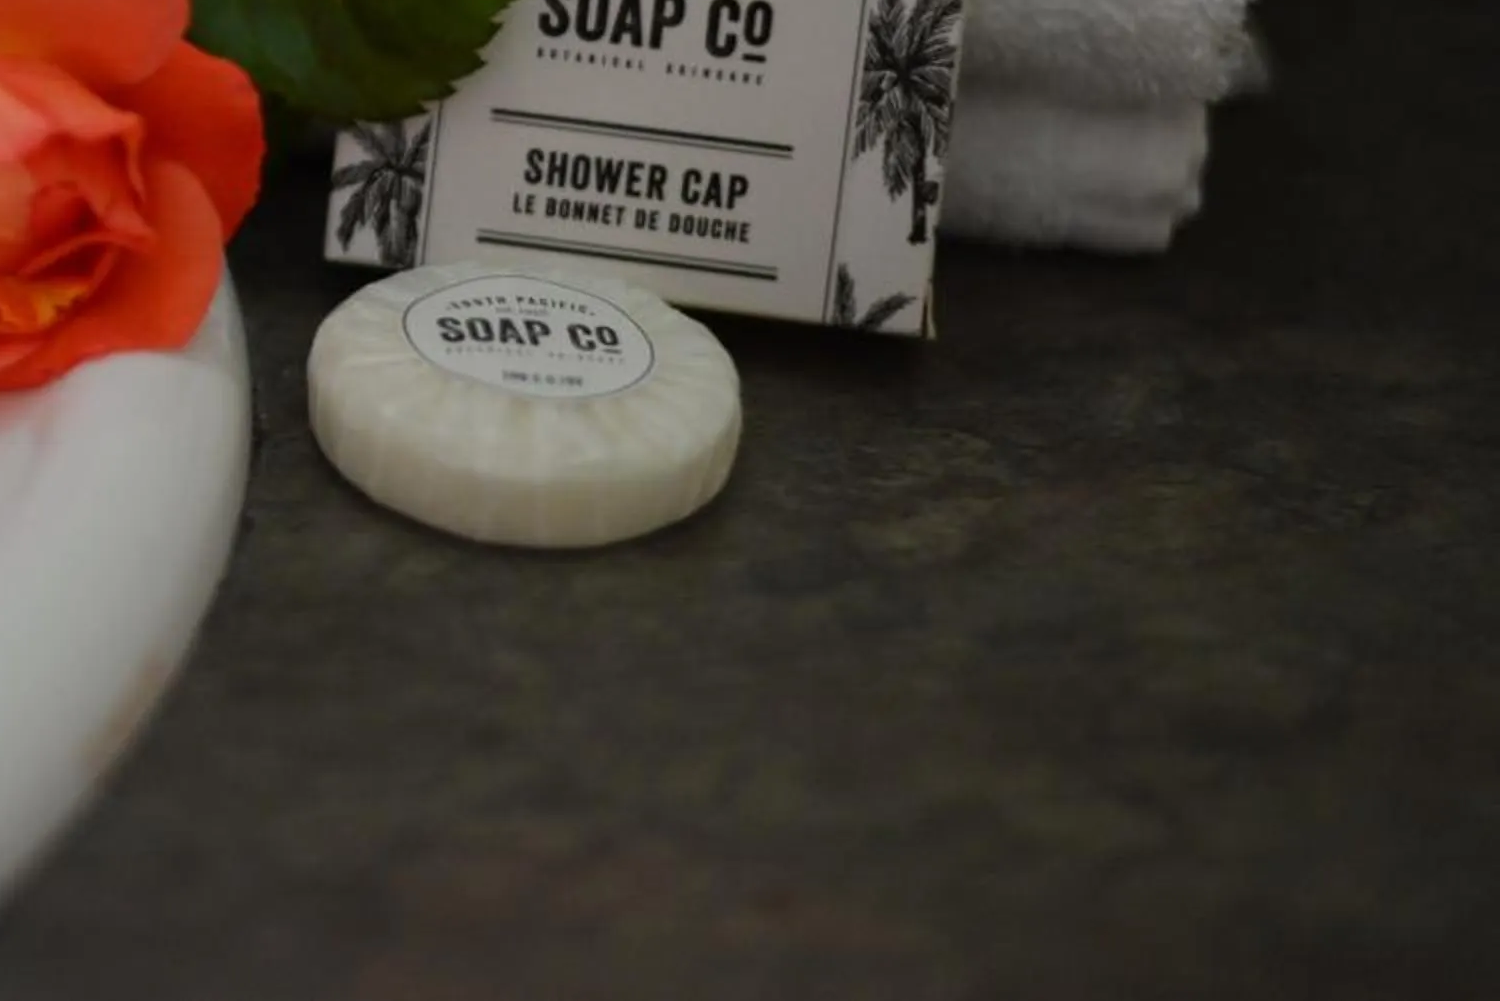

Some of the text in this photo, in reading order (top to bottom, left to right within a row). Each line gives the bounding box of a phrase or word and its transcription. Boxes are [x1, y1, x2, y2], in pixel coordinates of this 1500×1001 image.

[523, 148, 750, 210] SHOWER CAP
[512, 192, 752, 244] LE BONNET DE DOUCHE
[515, 295, 588, 315] PACIFIC
[436, 316, 551, 346] SOAP
